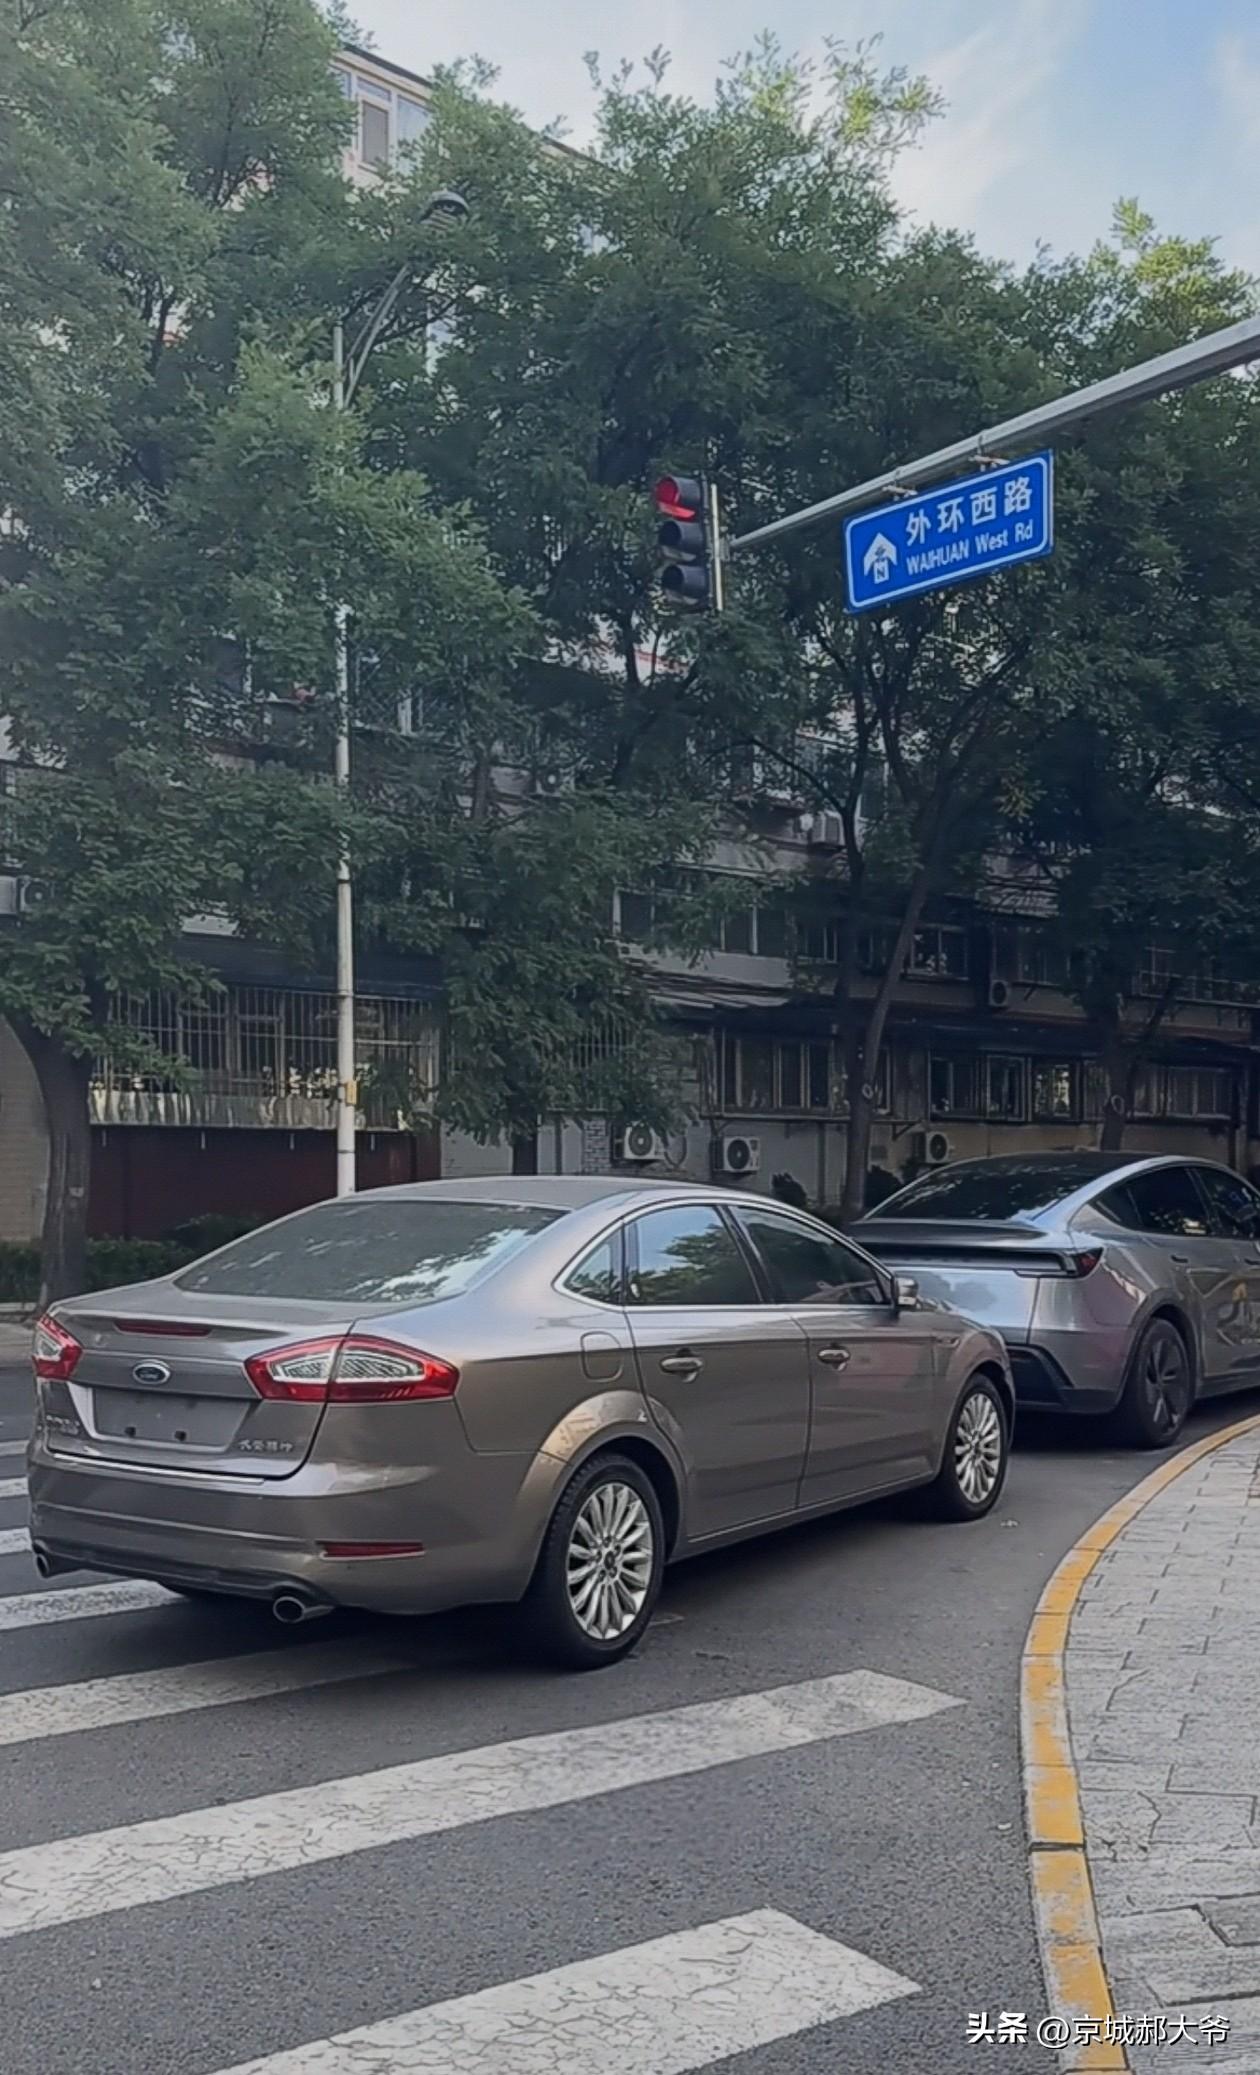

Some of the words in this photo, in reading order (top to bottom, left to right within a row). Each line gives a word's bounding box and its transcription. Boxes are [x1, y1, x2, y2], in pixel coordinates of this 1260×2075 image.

[905, 476, 1032, 546] 外环西路
[906, 538, 970, 575] WAIHUAN
[975, 529, 1008, 554] West
[1014, 519, 1033, 543] Rd
